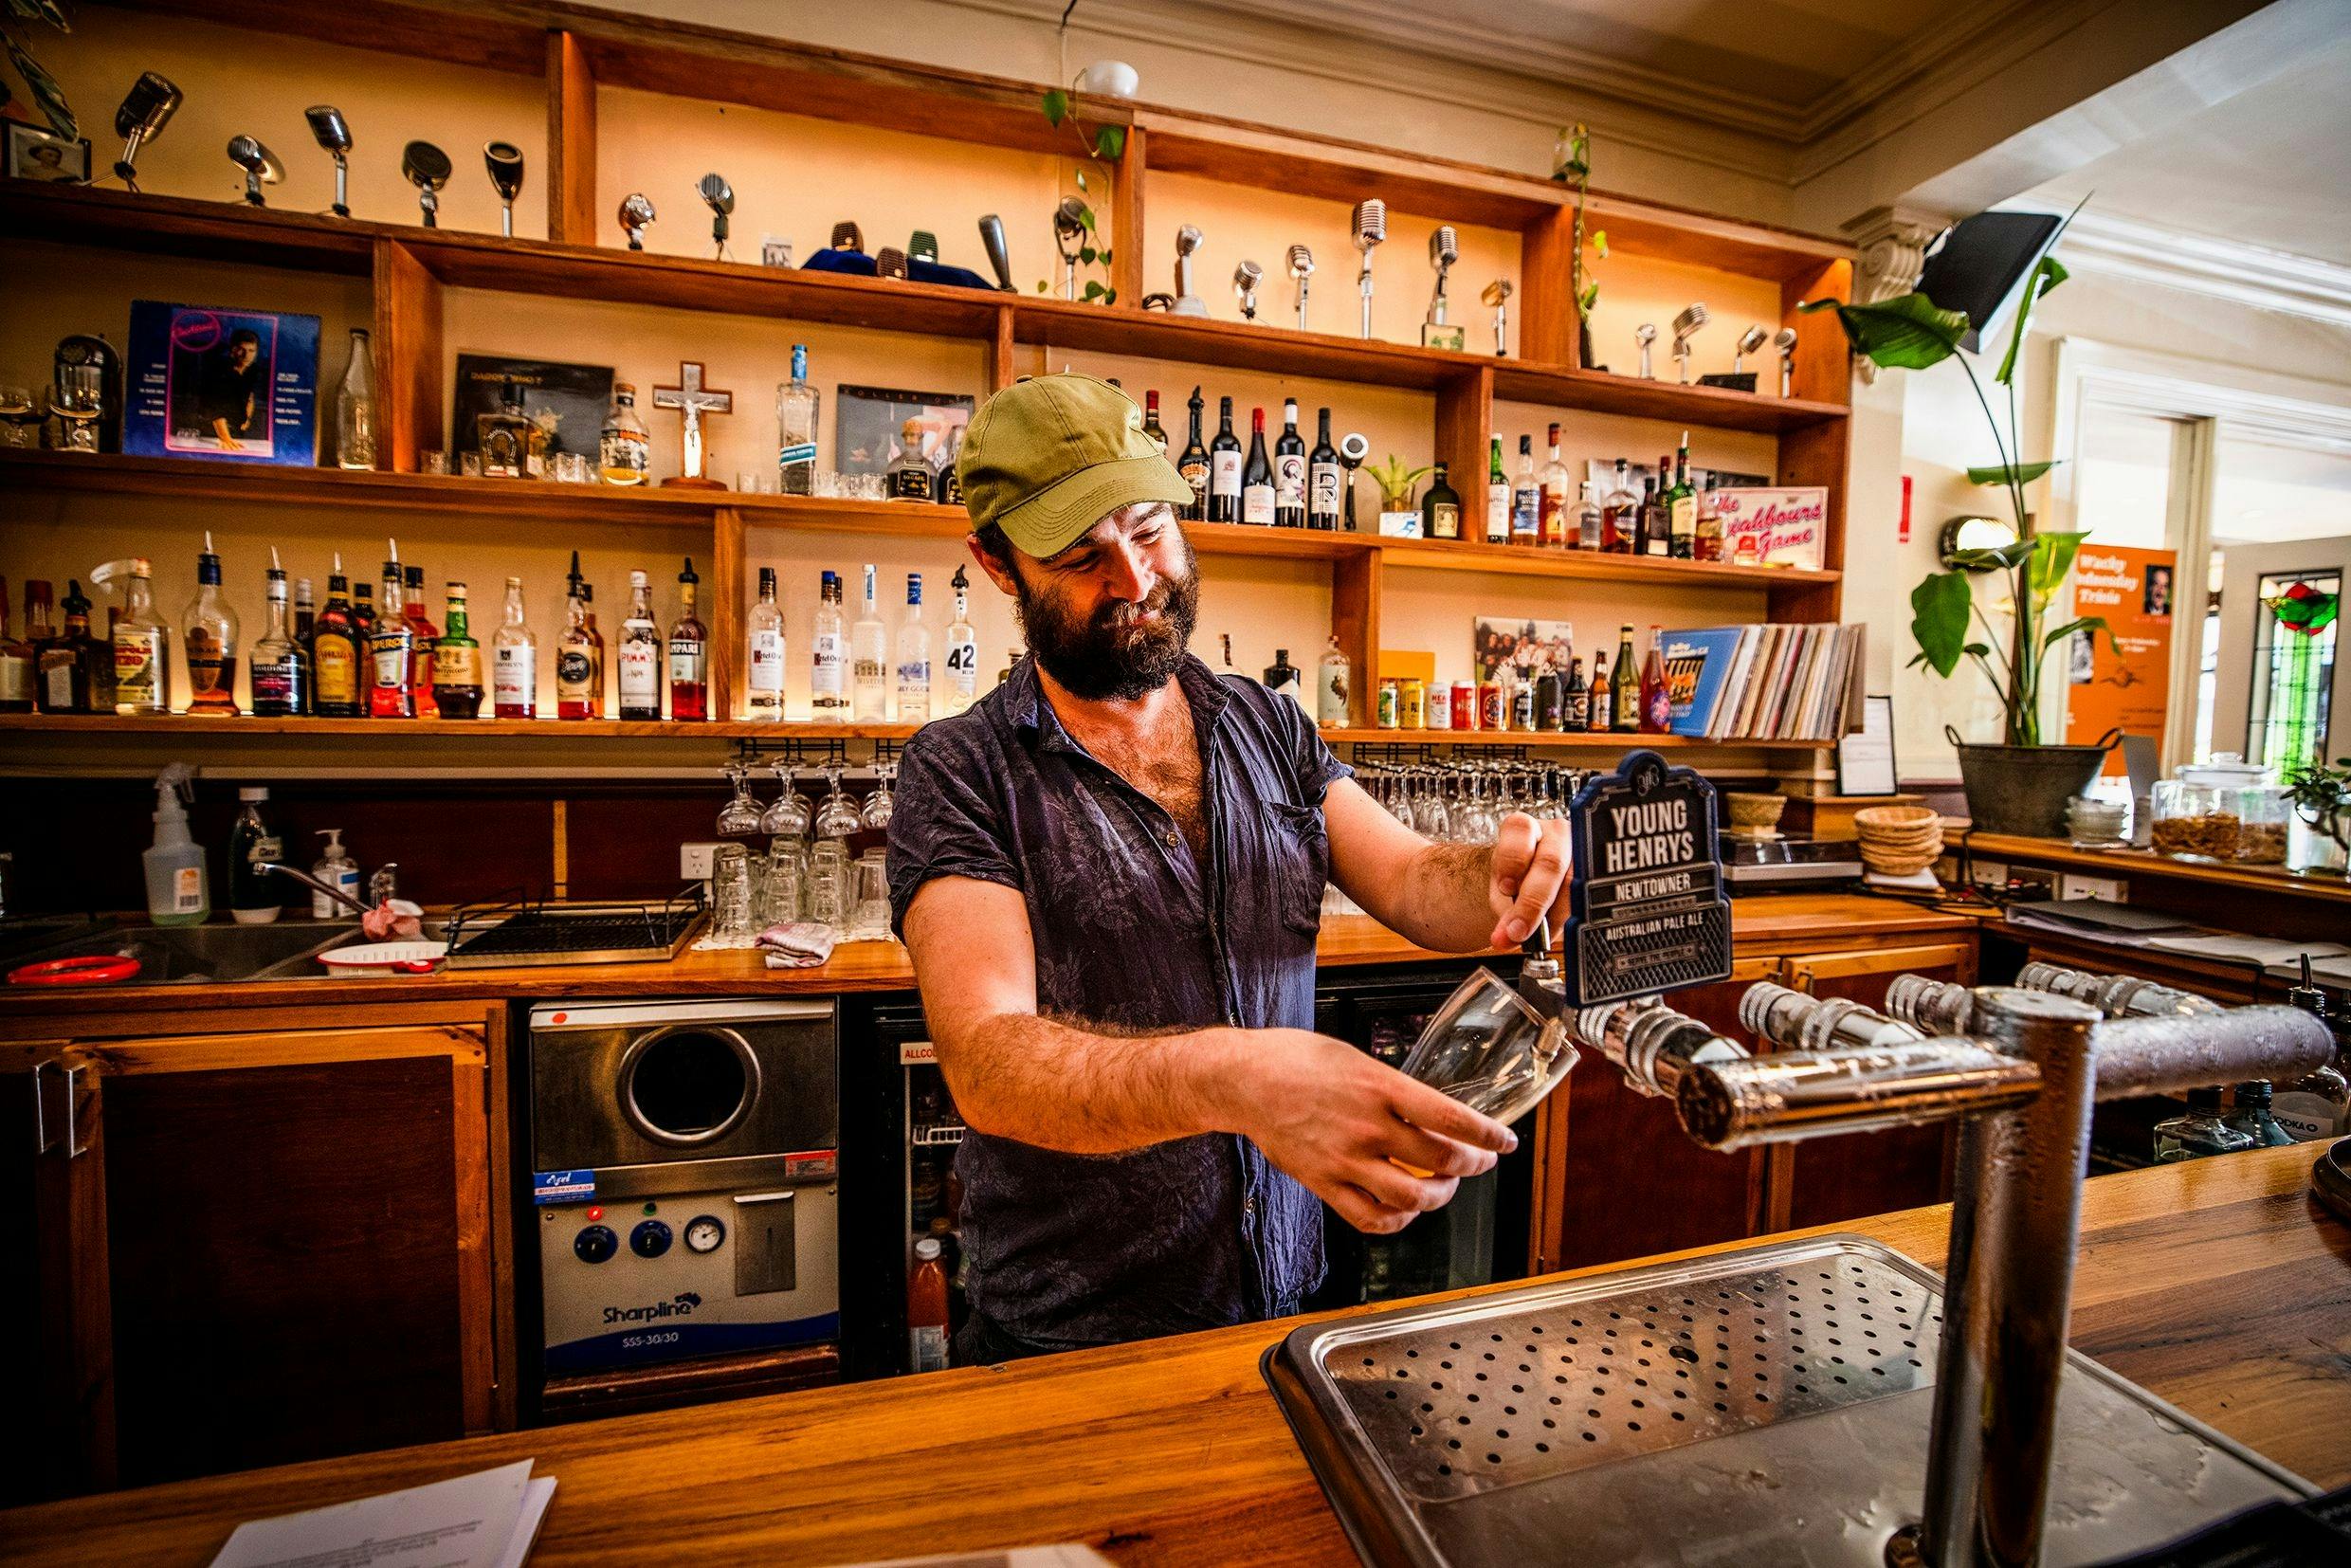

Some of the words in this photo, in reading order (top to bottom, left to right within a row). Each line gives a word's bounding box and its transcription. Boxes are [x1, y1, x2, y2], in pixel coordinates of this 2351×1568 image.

[2077, 572, 2139, 592] ednesday
[947, 645, 975, 670] 42
[1611, 799, 1687, 839] YOUNG
[1606, 831, 1694, 873] HENRYS
[1615, 872, 1691, 902] NEWTOWNER
[1606, 920, 1662, 941] AUSTRALIAN
[1663, 914, 1685, 930] PALE
[1687, 911, 1704, 926] ALE
[603, 1301, 692, 1324] Sharpline
